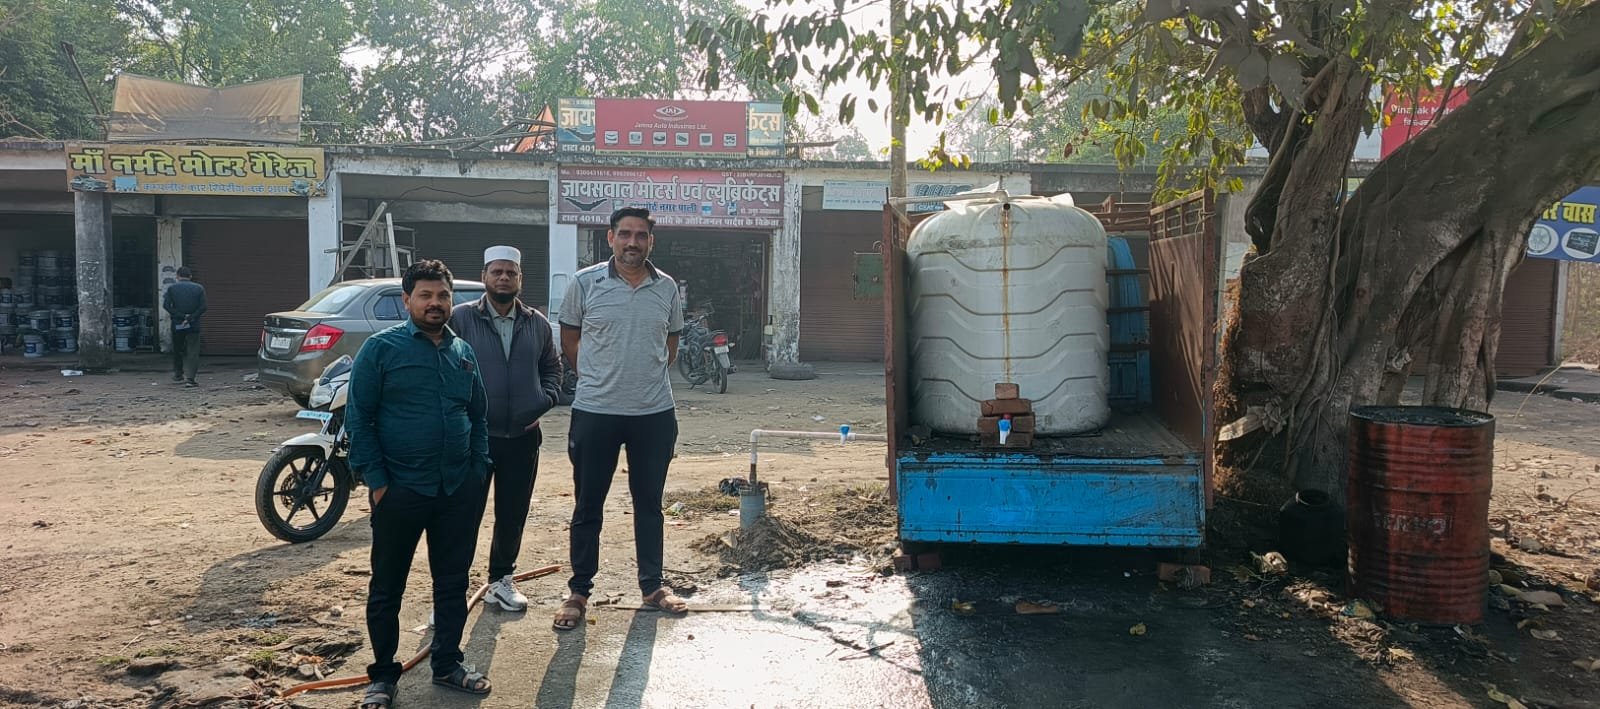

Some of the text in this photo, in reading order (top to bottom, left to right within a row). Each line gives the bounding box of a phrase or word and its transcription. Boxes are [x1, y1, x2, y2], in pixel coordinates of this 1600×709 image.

[560, 107, 595, 127] जाय
[1391, 104, 1429, 114] Vinaak
[579, 144, 595, 153] 401
[178, 151, 248, 177] मोटर
[248, 151, 317, 178] गैरेज
[560, 180, 635, 199] जायसवाल
[637, 175, 679, 200] मोटर्स
[679, 179, 704, 200] एवं
[1562, 202, 1598, 224] वास
